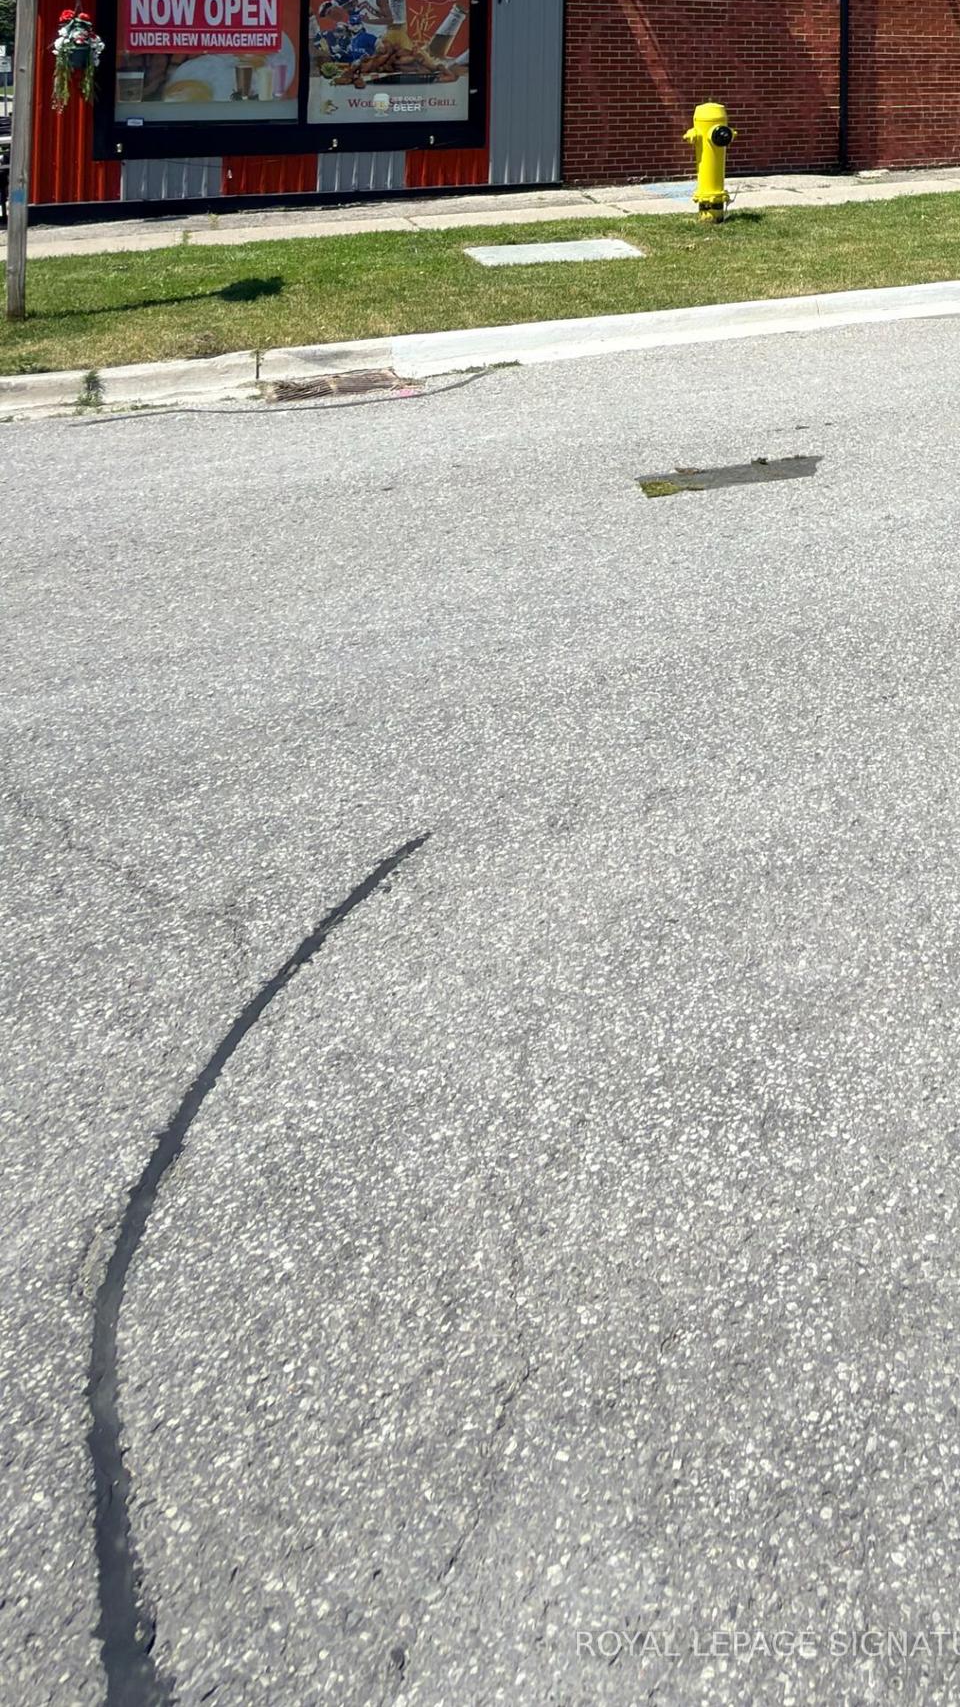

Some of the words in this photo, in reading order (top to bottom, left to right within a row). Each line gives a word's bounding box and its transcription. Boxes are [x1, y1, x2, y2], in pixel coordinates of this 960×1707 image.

[130, 32, 171, 47] UNDER
[173, 33, 199, 47] NEW
[201, 33, 278, 48] MANAGEMENT
[393, 103, 422, 113] BEER
[428, 96, 457, 108] GRILL
